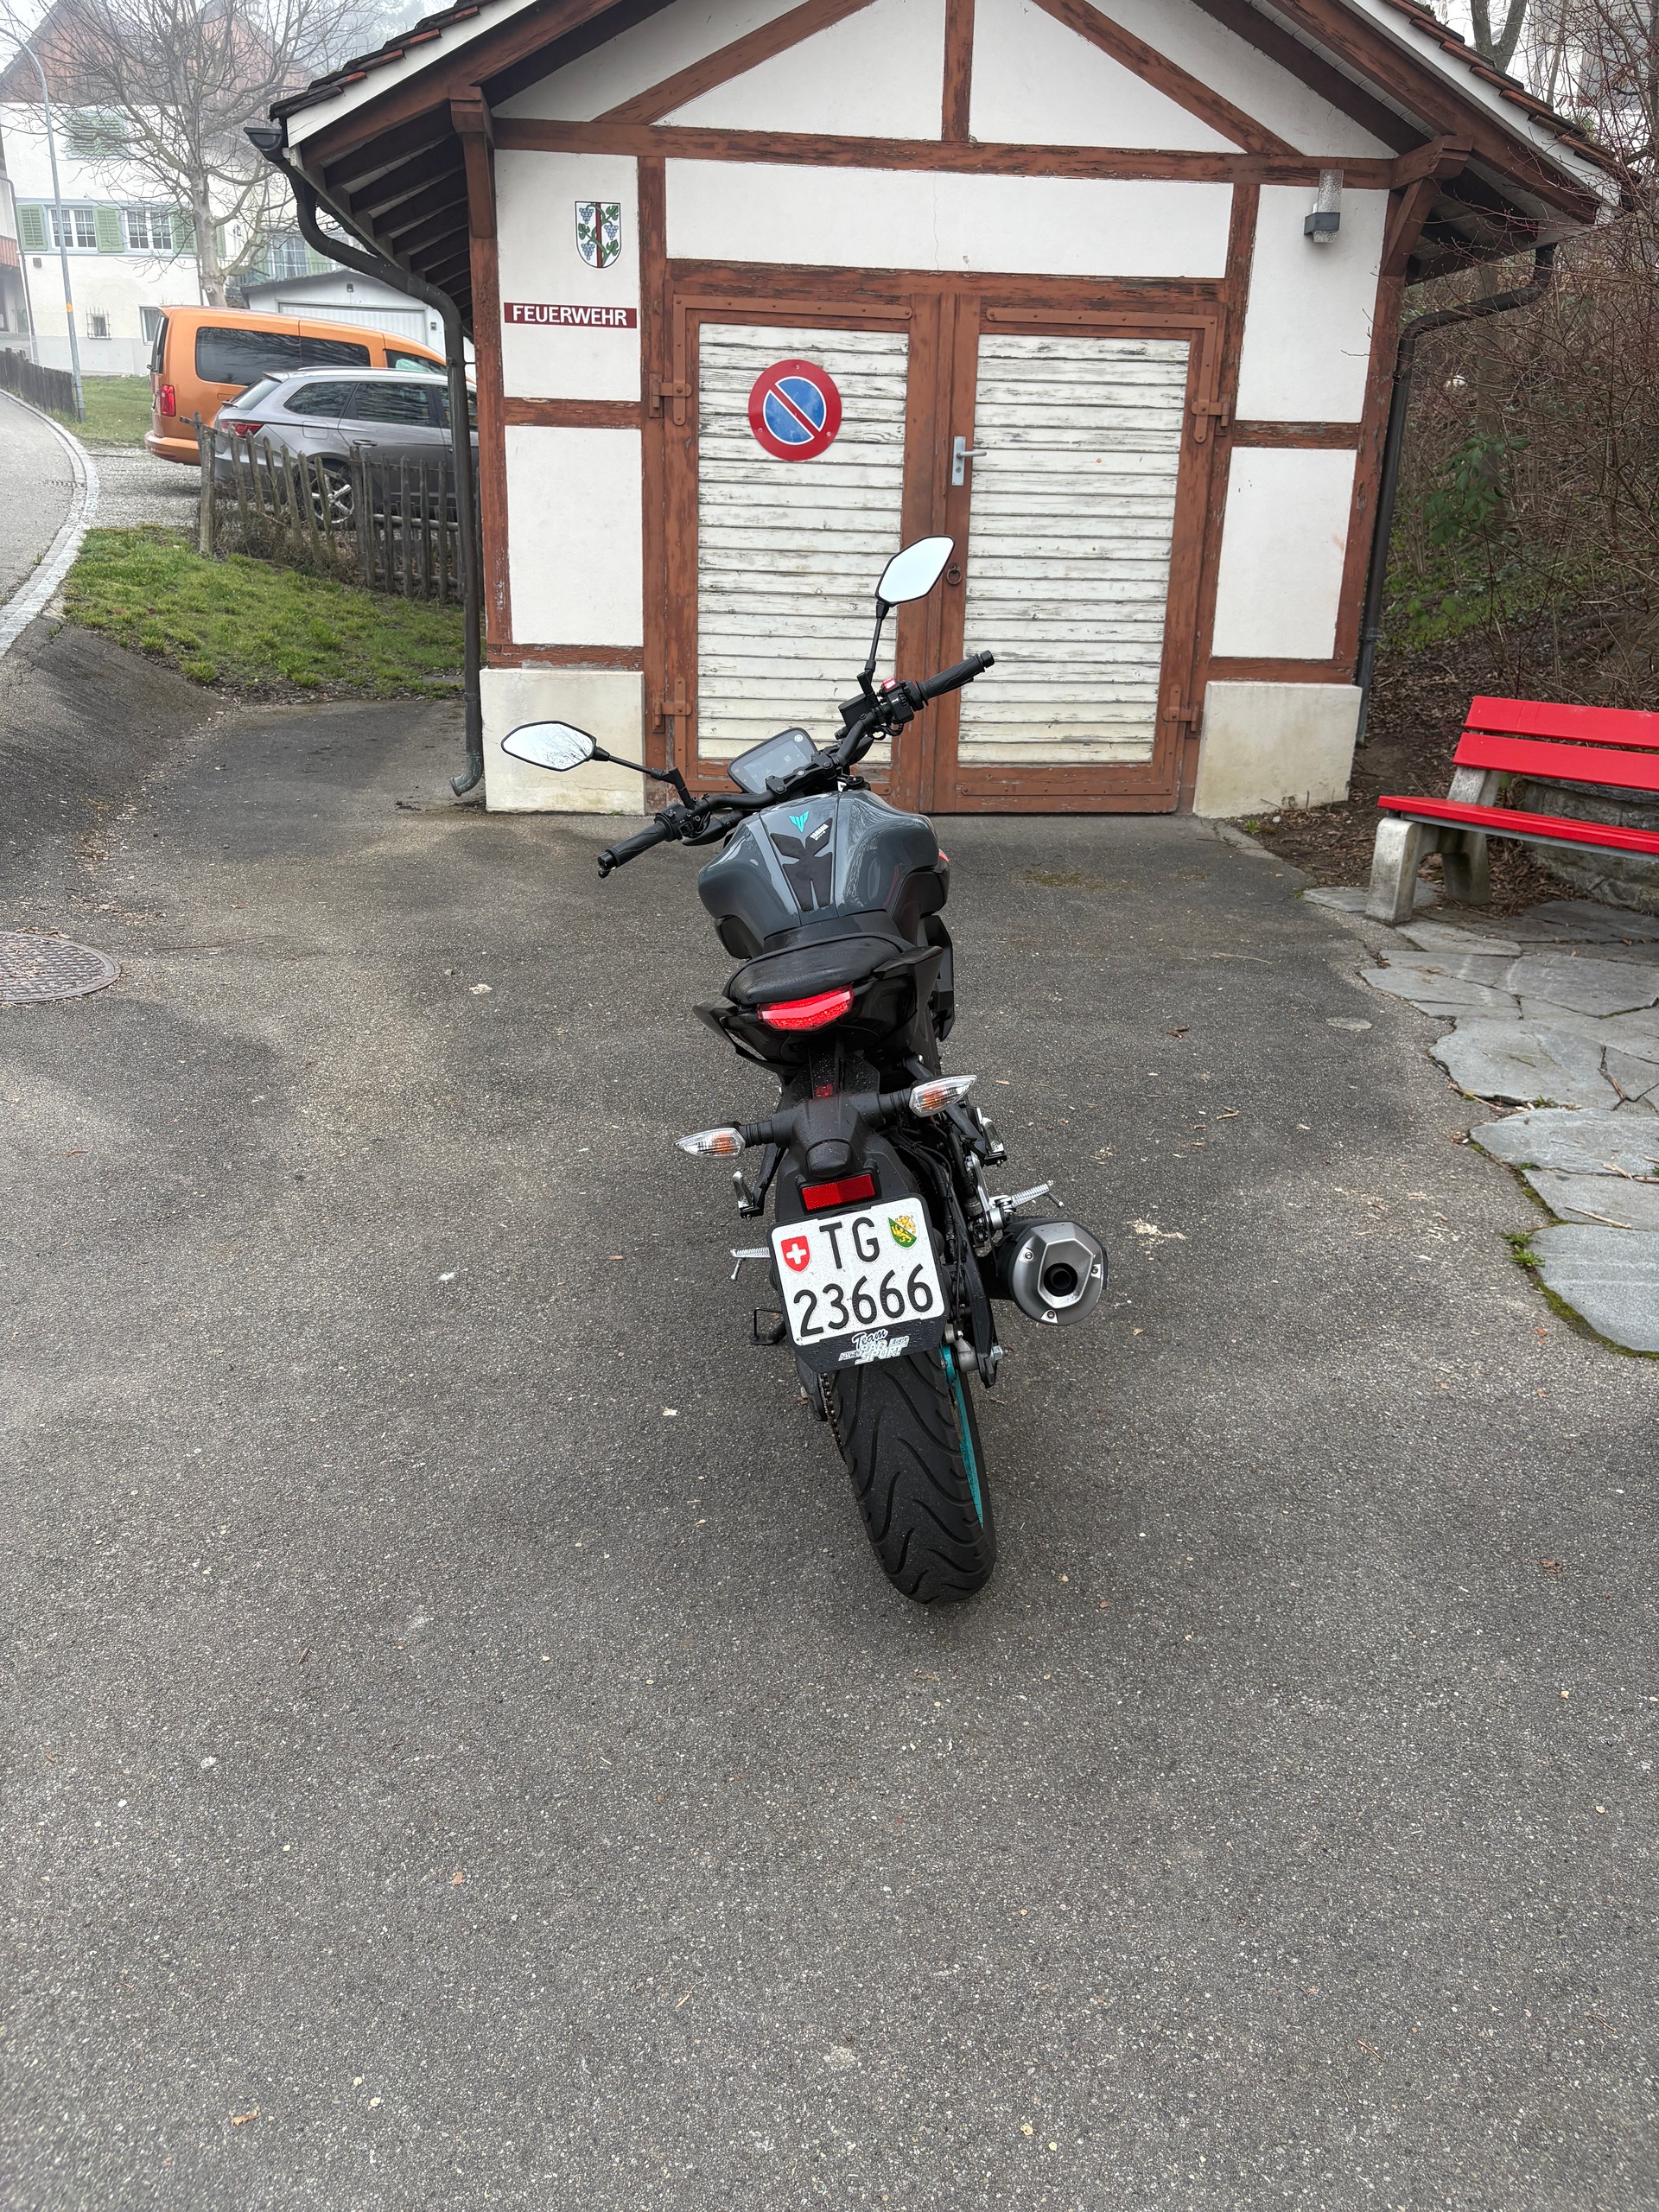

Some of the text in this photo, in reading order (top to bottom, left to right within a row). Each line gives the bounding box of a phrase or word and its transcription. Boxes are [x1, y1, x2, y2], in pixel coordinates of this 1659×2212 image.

[512, 305, 627, 326] FEUERWEHR
[818, 1217, 880, 1269] TG
[793, 1263, 933, 1338] 23666
[851, 1328, 888, 1351] Team
[855, 1345, 903, 1365] SPORT
